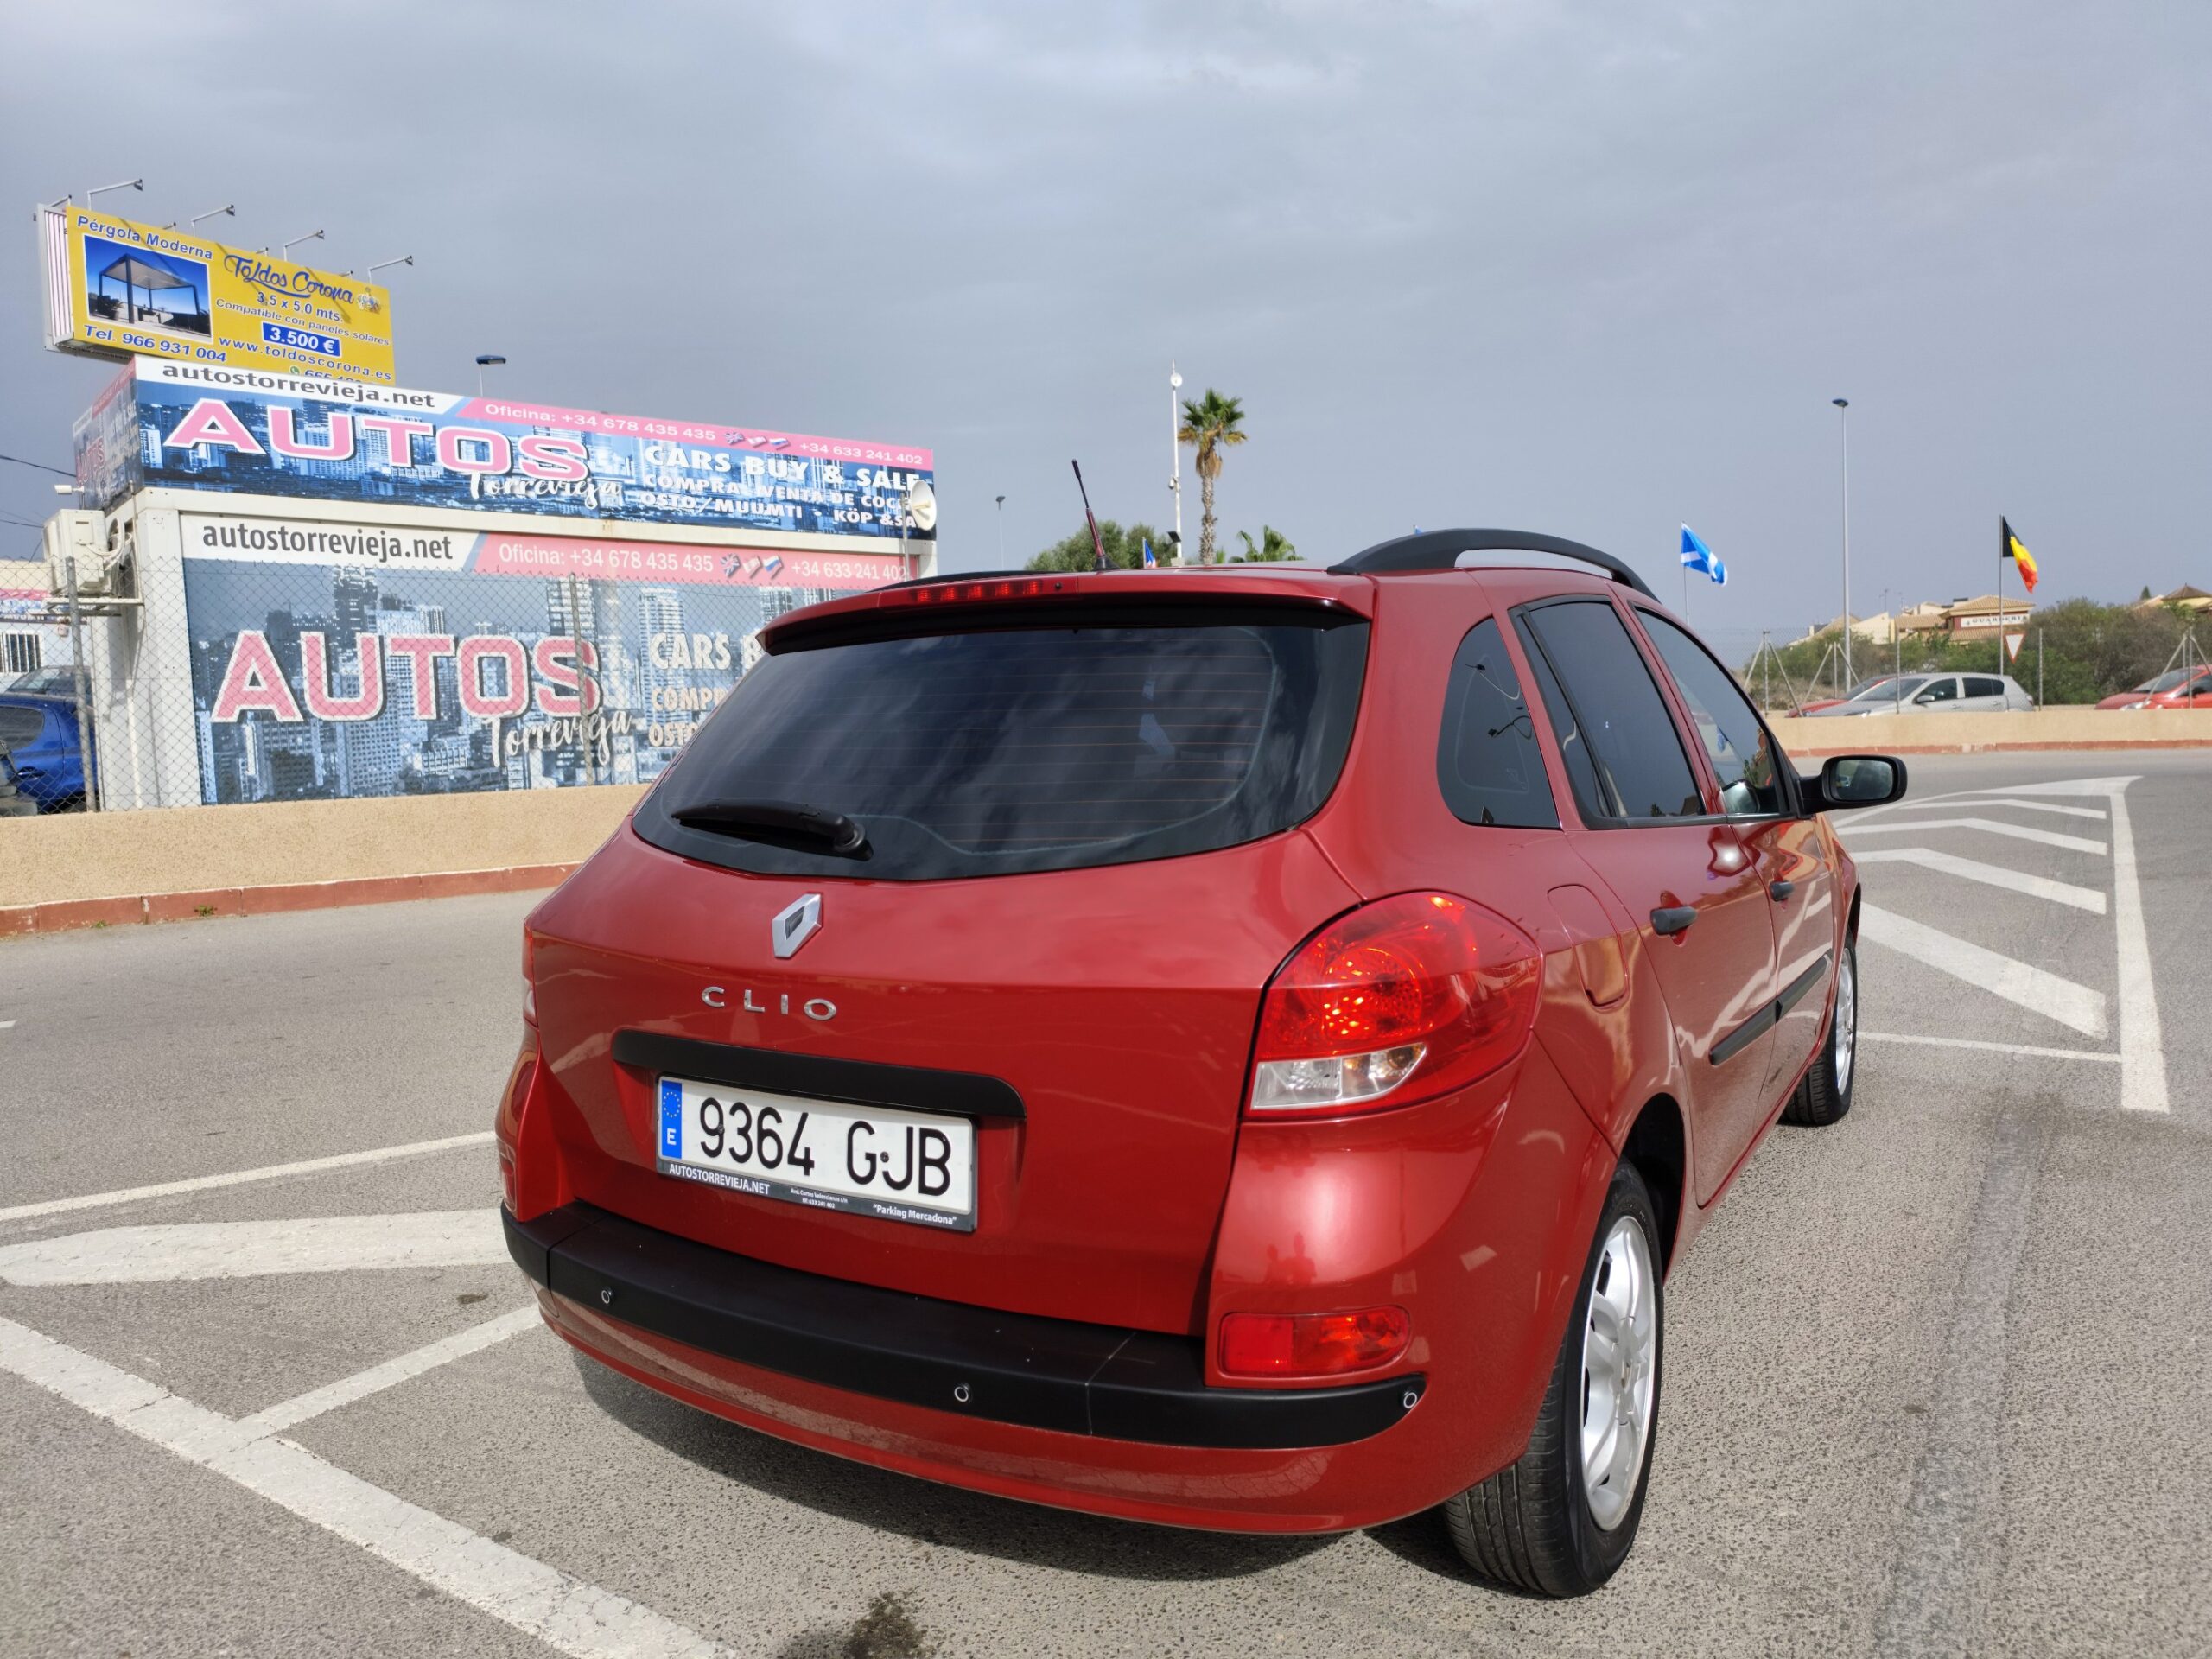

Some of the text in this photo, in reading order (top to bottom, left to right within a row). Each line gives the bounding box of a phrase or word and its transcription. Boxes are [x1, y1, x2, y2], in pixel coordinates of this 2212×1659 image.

[77, 215, 213, 260] Pérgola Moderna
[224, 254, 355, 305] Toldos Corona
[216, 298, 390, 346] Compatible con paneles solares
[281, 300, 289, 308] x
[122, 333, 156, 349] 966
[160, 340, 191, 355] 931
[196, 347, 226, 363] 004
[219, 337, 392, 380] www.toldoscorona.es
[270, 327, 336, 354] 3.500 €
[162, 363, 435, 409] autostorrevieja.net
[162, 397, 591, 482] AUTOS
[485, 403, 924, 466] Oficina: +34 678 435 435 +34 633 241 402
[645, 445, 733, 473] CARS
[744, 455, 810, 481] BUY
[822, 464, 845, 485] &
[463, 471, 624, 510] Torrevieja
[645, 474, 741, 496] COMPRA
[831, 492, 855, 505] DE
[833, 507, 874, 524] KÖP
[202, 523, 453, 563] autostorrevieja.net
[499, 543, 566, 565] Oficina:
[569, 547, 604, 567] +34
[608, 550, 642, 569] 678
[646, 552, 678, 570] 435
[683, 554, 714, 572] 435
[791, 560, 820, 578] +34
[823, 561, 852, 579] 633
[855, 563, 880, 580] 241
[650, 632, 732, 670] CARS
[210, 630, 601, 722] AUTOS
[483, 709, 632, 767] Torreveja
[701, 985, 837, 1020] CLIO
[667, 1128, 677, 1145] E
[699, 1096, 952, 1196] 9364 GJB
[669, 1163, 771, 1196] AUTOSTORREVIEJA.NET
